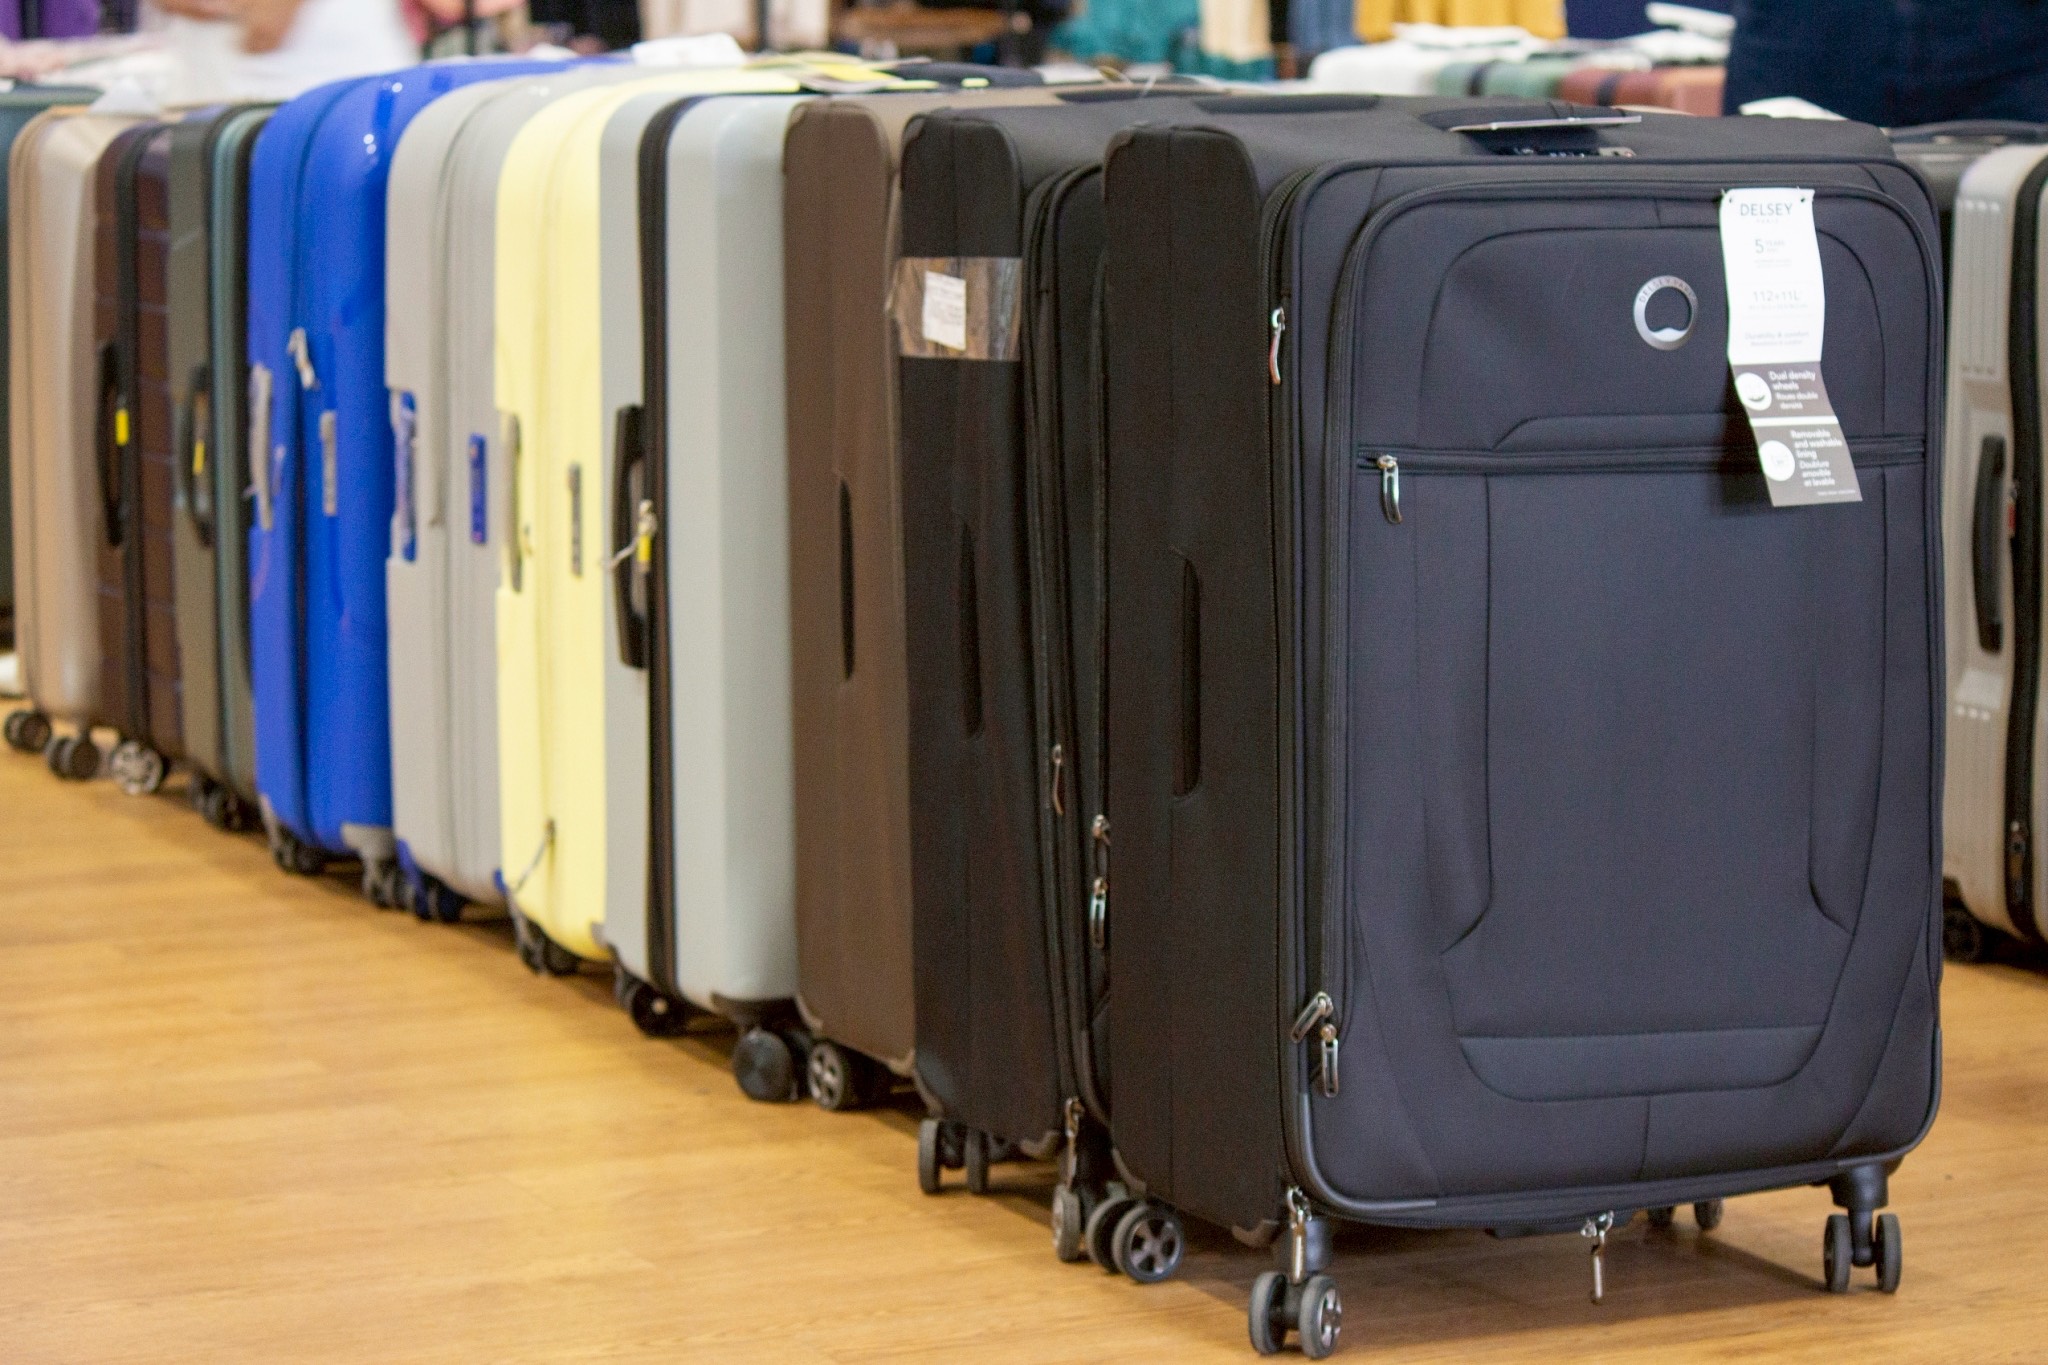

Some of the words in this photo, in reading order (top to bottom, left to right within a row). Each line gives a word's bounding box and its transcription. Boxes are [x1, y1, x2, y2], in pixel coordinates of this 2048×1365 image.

[1740, 203, 1793, 216] DELSEY
[1754, 238, 1764, 254] 5
[1639, 278, 1671, 303] DELSEY
[1768, 371, 1788, 381] Dual
[1788, 370, 1816, 382] density
[1772, 381, 1800, 391] wheels
[1796, 391, 1819, 400] double
[1790, 429, 1831, 439] Removable
[1794, 439, 1809, 448] and
[1809, 438, 1843, 448] washable
[1802, 468, 1832, 478] amovible
[1812, 477, 1836, 487] lavable
